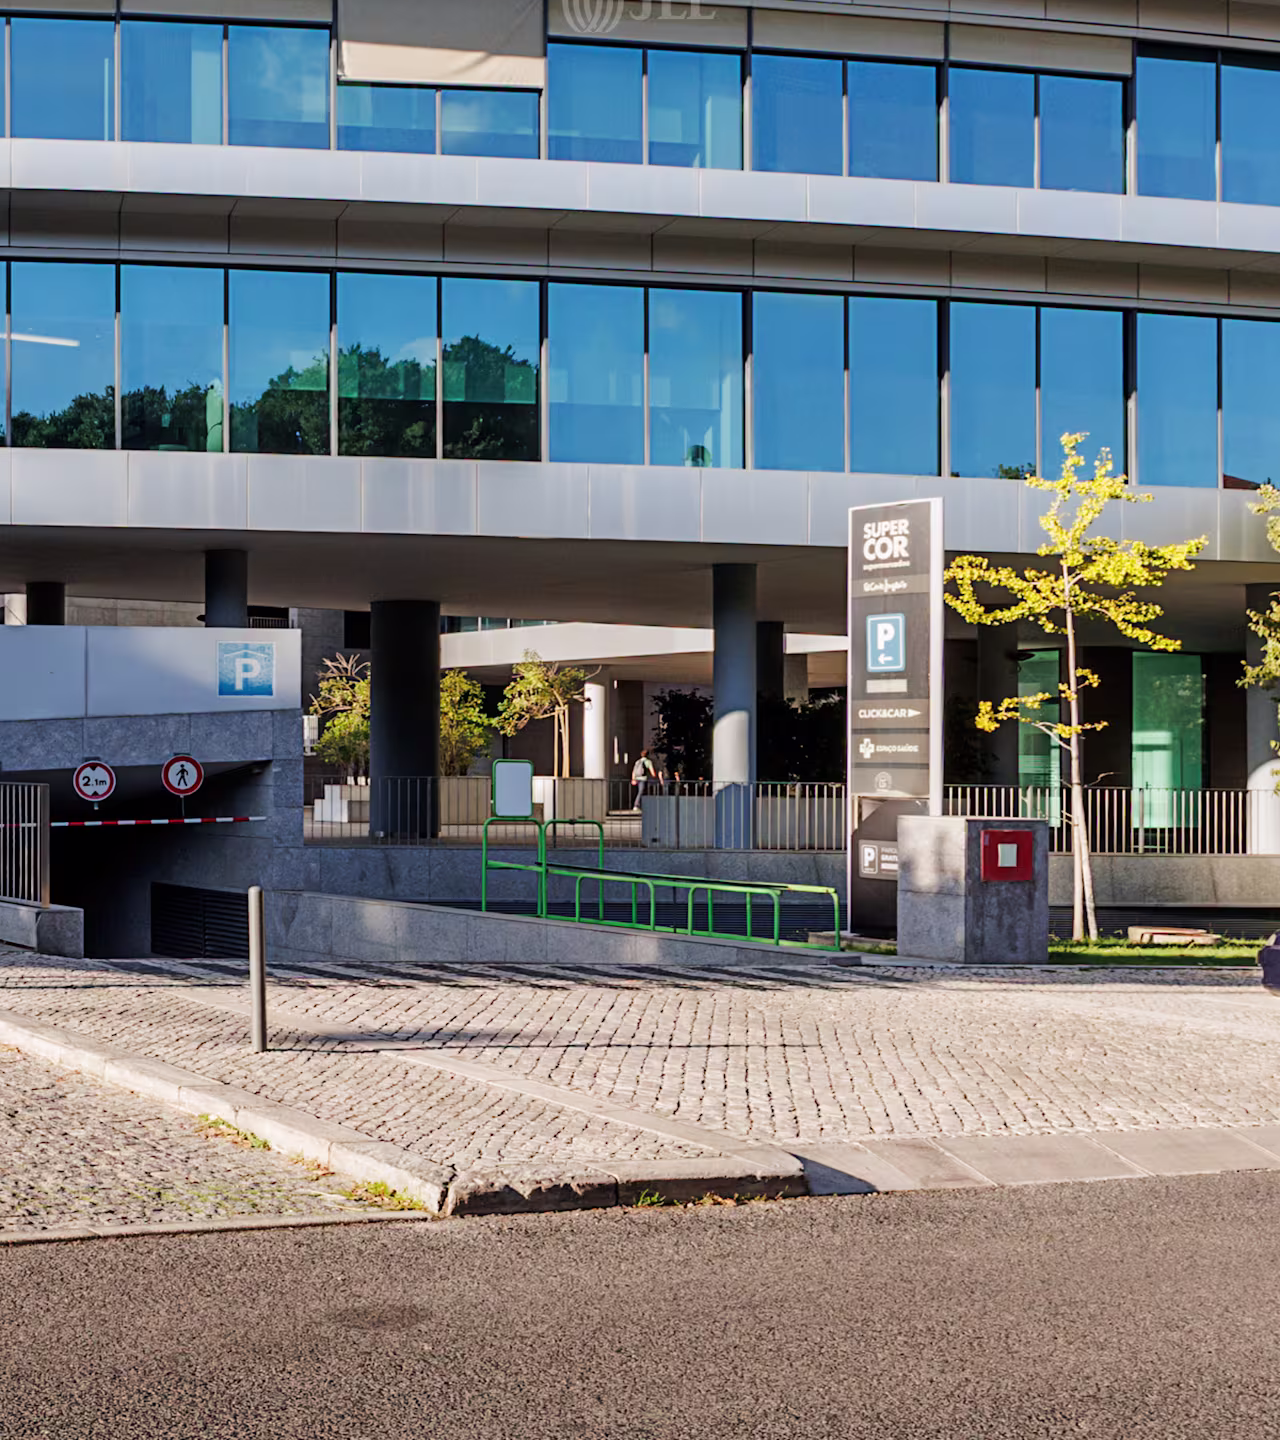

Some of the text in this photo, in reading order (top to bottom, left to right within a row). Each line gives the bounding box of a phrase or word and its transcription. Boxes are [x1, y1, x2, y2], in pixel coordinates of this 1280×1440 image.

[863, 518, 910, 540] SUPER
[863, 535, 910, 561] COR
[877, 623, 895, 650] P
[234, 657, 261, 691] P
[858, 708, 907, 719] CLICK&CAR
[82, 775, 107, 787] 2.1m
[863, 847, 875, 867] P
